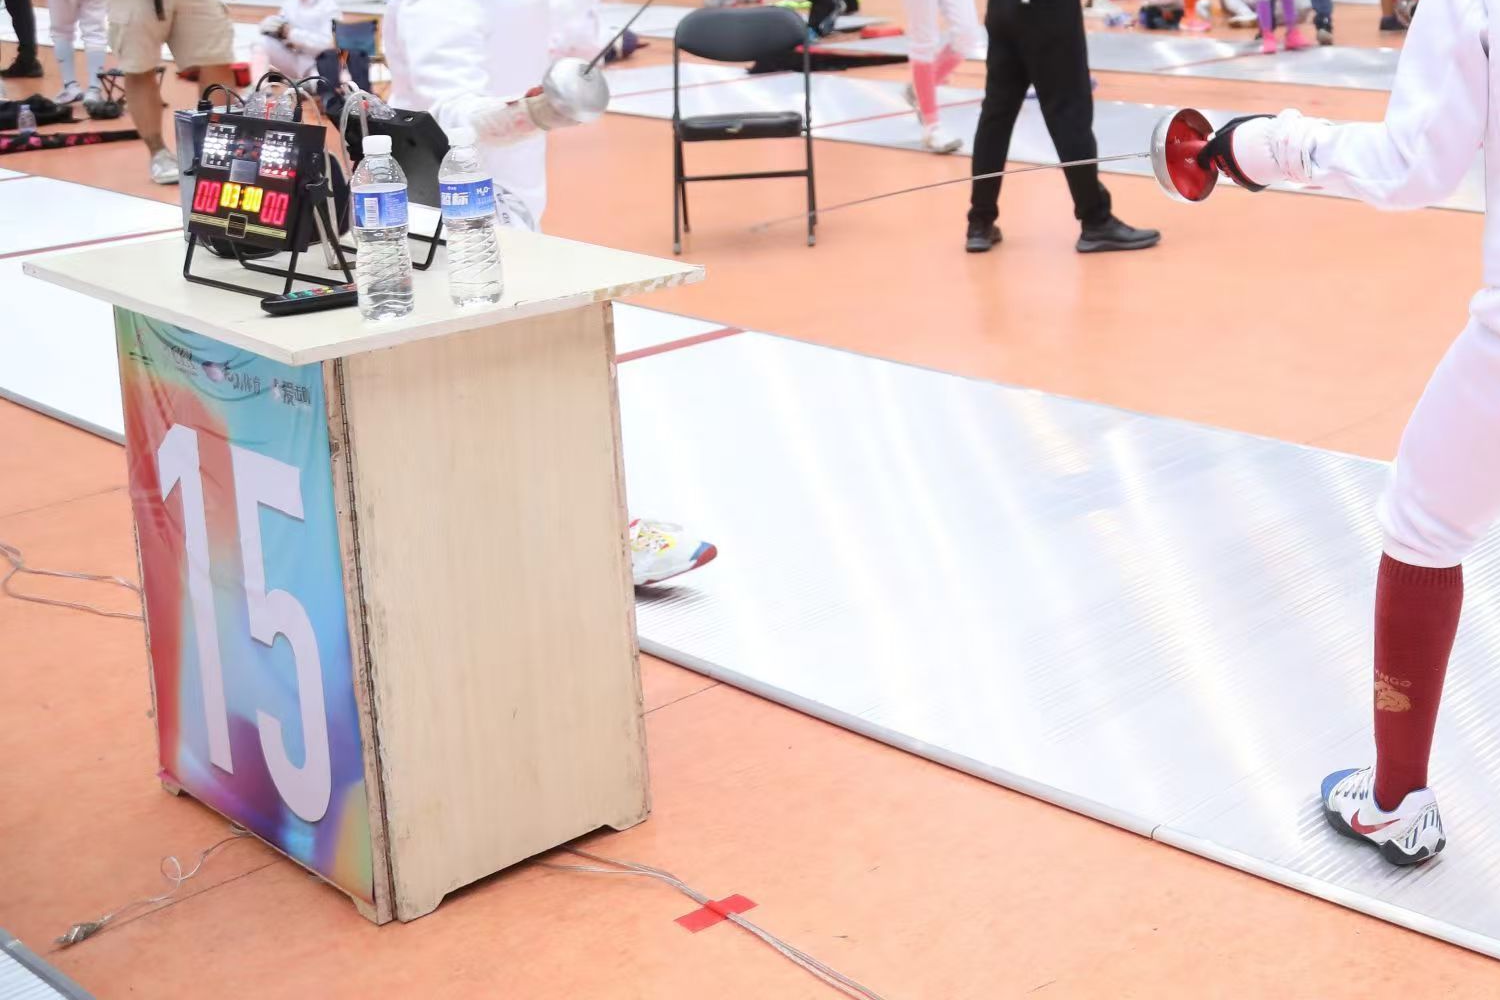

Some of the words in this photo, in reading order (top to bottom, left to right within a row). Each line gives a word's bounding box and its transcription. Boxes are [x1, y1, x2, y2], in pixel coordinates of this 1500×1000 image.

[193, 180, 221, 213] 00
[260, 191, 290, 226] 00
[156, 422, 332, 823] 15
